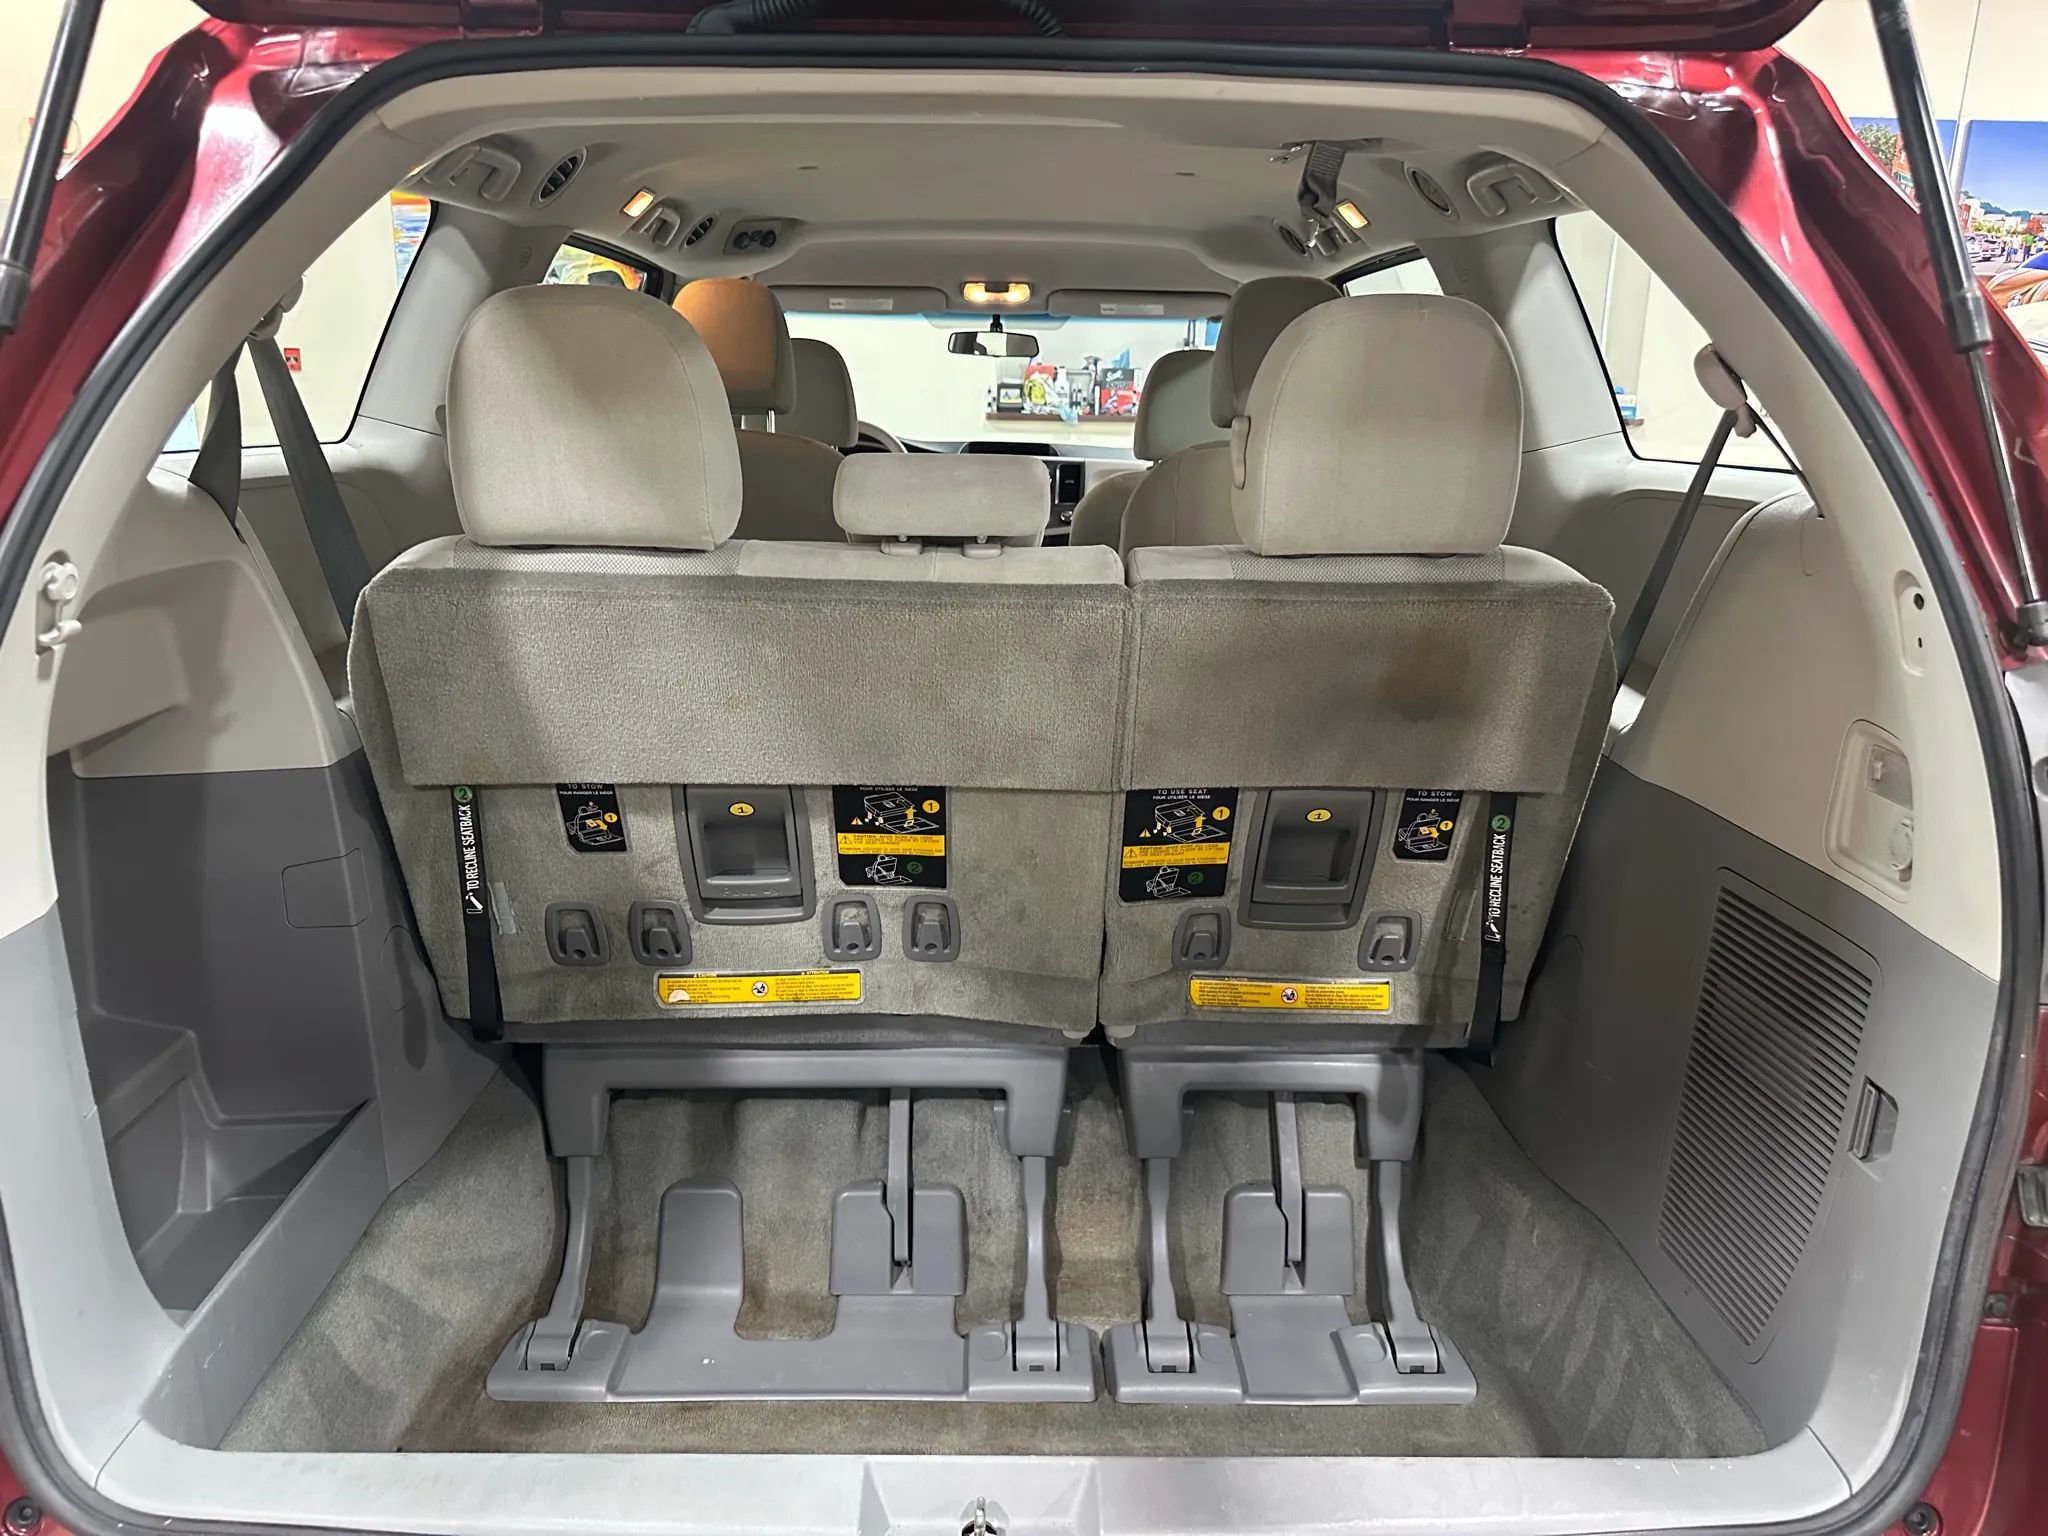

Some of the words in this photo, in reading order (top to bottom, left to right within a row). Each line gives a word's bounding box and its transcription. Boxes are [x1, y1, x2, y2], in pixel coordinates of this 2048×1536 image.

[458, 804, 475, 847] SEATBACK
[462, 846, 479, 880] RECLINE
[1490, 833, 1506, 874] SEATBACK
[466, 880, 480, 891] TO
[1489, 874, 1504, 905] RECLINE
[1488, 905, 1500, 918] TO
